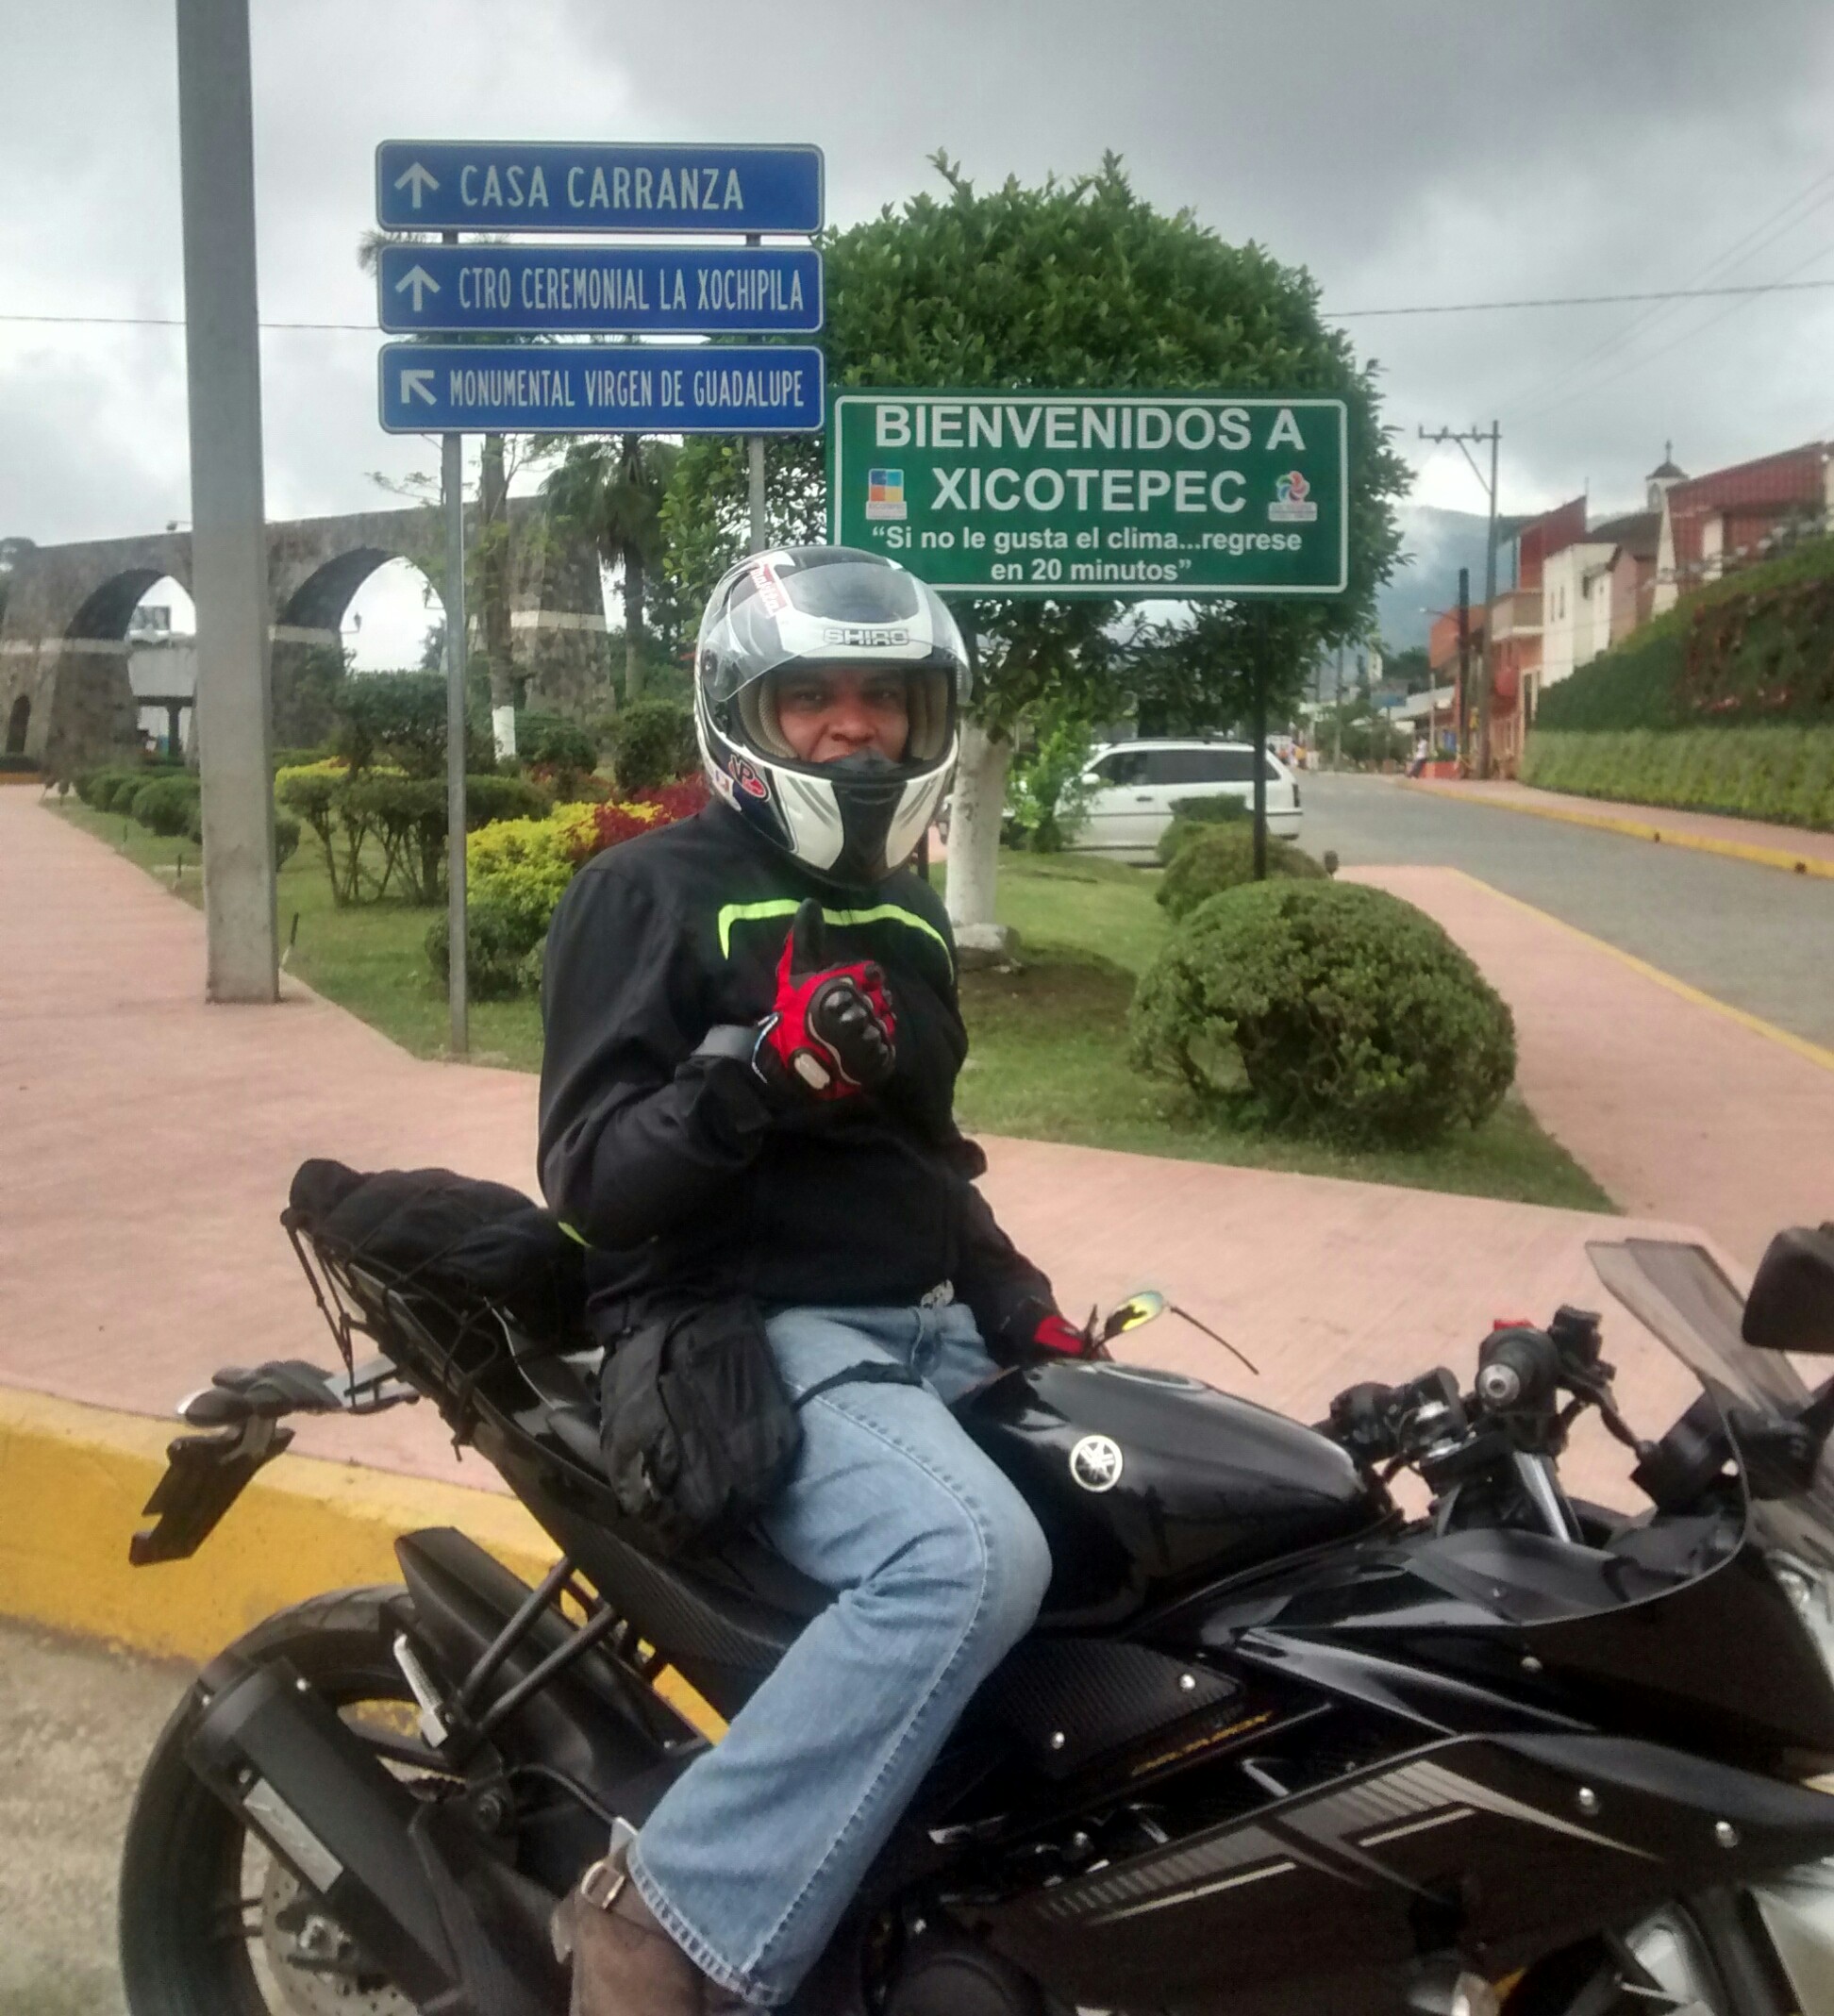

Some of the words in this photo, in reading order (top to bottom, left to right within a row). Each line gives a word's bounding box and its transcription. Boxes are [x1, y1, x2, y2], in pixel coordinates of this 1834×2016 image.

[459, 164, 549, 208] CASA
[567, 166, 744, 210] CARRANZA
[458, 267, 511, 309] CTRO
[522, 268, 649, 310] CEREMONIAL
[660, 269, 687, 310] LA
[698, 269, 804, 311] XOCHIPILA
[450, 370, 575, 408] MONUMENTAL
[585, 370, 653, 408] VIRGEN
[661, 370, 684, 408] DE
[693, 370, 805, 408] GUADALUPE
[875, 405, 1252, 451] BIENVENIDOS
[1265, 408, 1307, 451] A
[930, 468, 1247, 513] XICOTEPEC
[921, 531, 955, 549] no
[963, 526, 986, 549] le
[993, 528, 1069, 556] gusta
[1076, 527, 1100, 550] el
[991, 563, 1023, 581] en
[1031, 558, 1062, 581] 20
[824, 628, 909, 646] SHIRO
